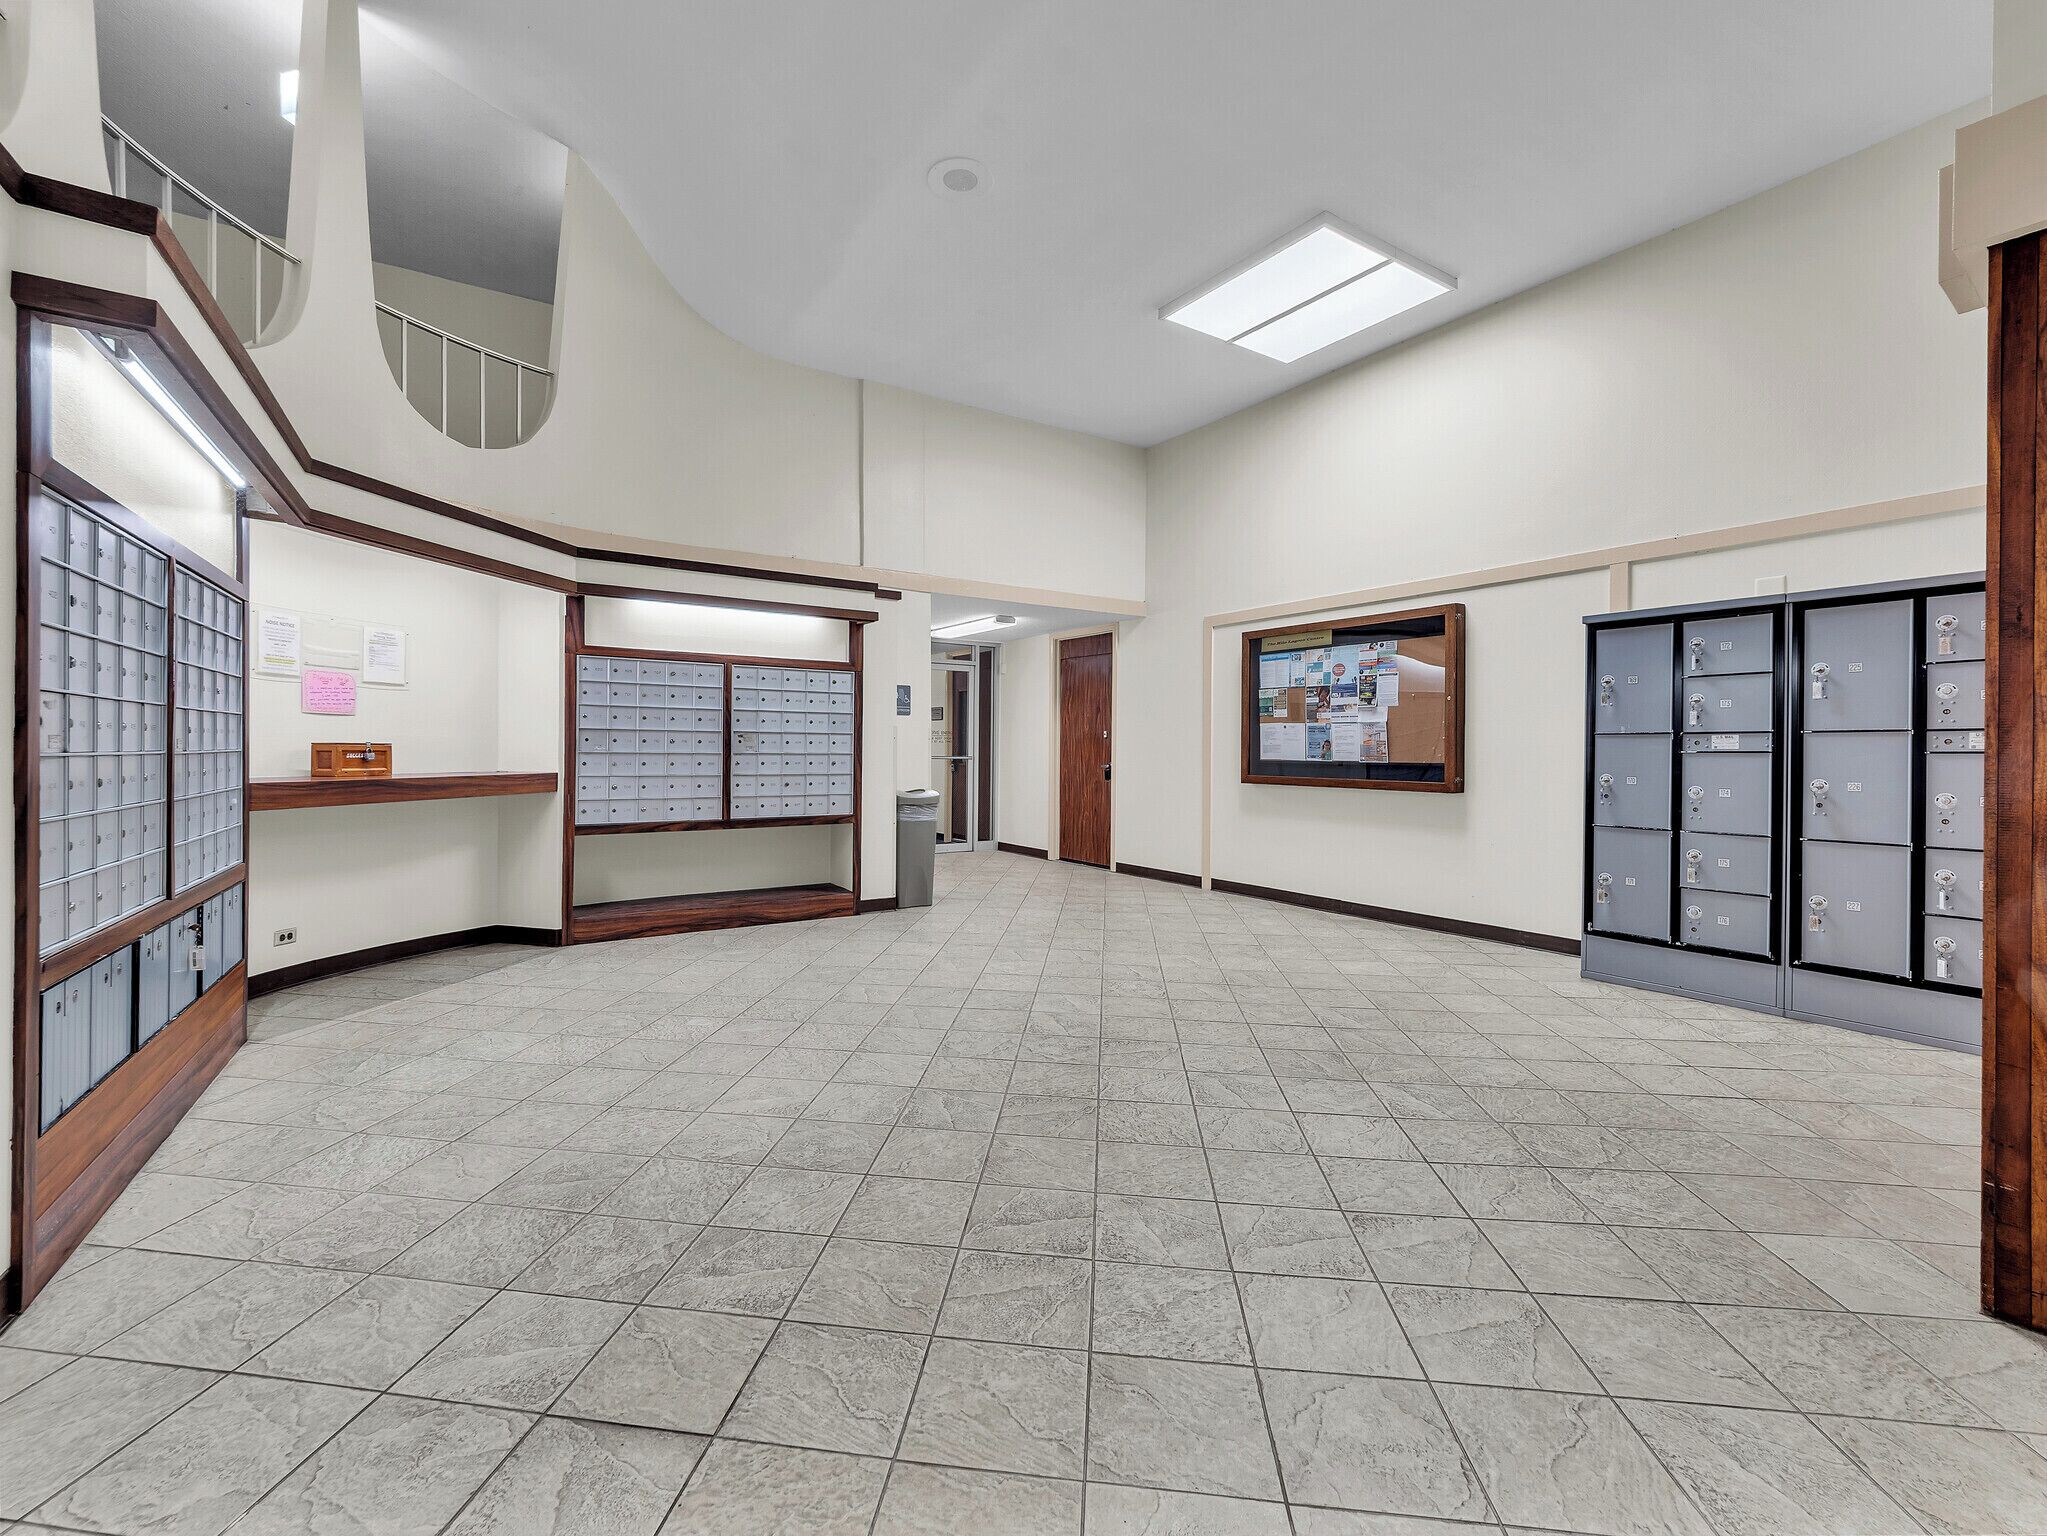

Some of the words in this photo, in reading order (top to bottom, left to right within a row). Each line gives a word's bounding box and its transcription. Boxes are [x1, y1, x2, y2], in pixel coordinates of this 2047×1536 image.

[1849, 663, 1862, 672] 225
[1848, 783, 1861, 791] 226
[1847, 901, 1860, 911] 227
